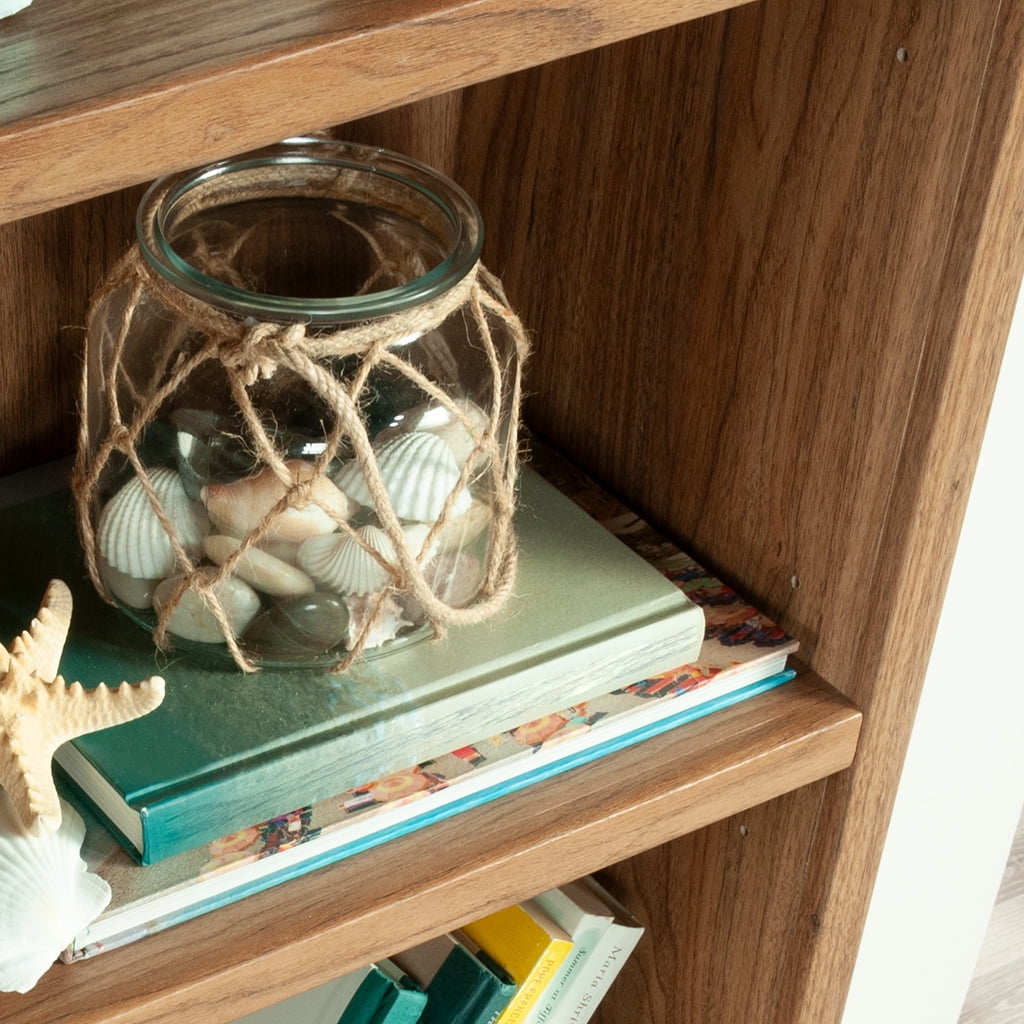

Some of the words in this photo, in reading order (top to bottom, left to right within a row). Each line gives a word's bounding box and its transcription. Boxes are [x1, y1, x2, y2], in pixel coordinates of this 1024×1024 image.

[537, 959, 556, 987] POPE
[559, 945, 587, 986] Summer
[591, 945, 623, 989] Maria
